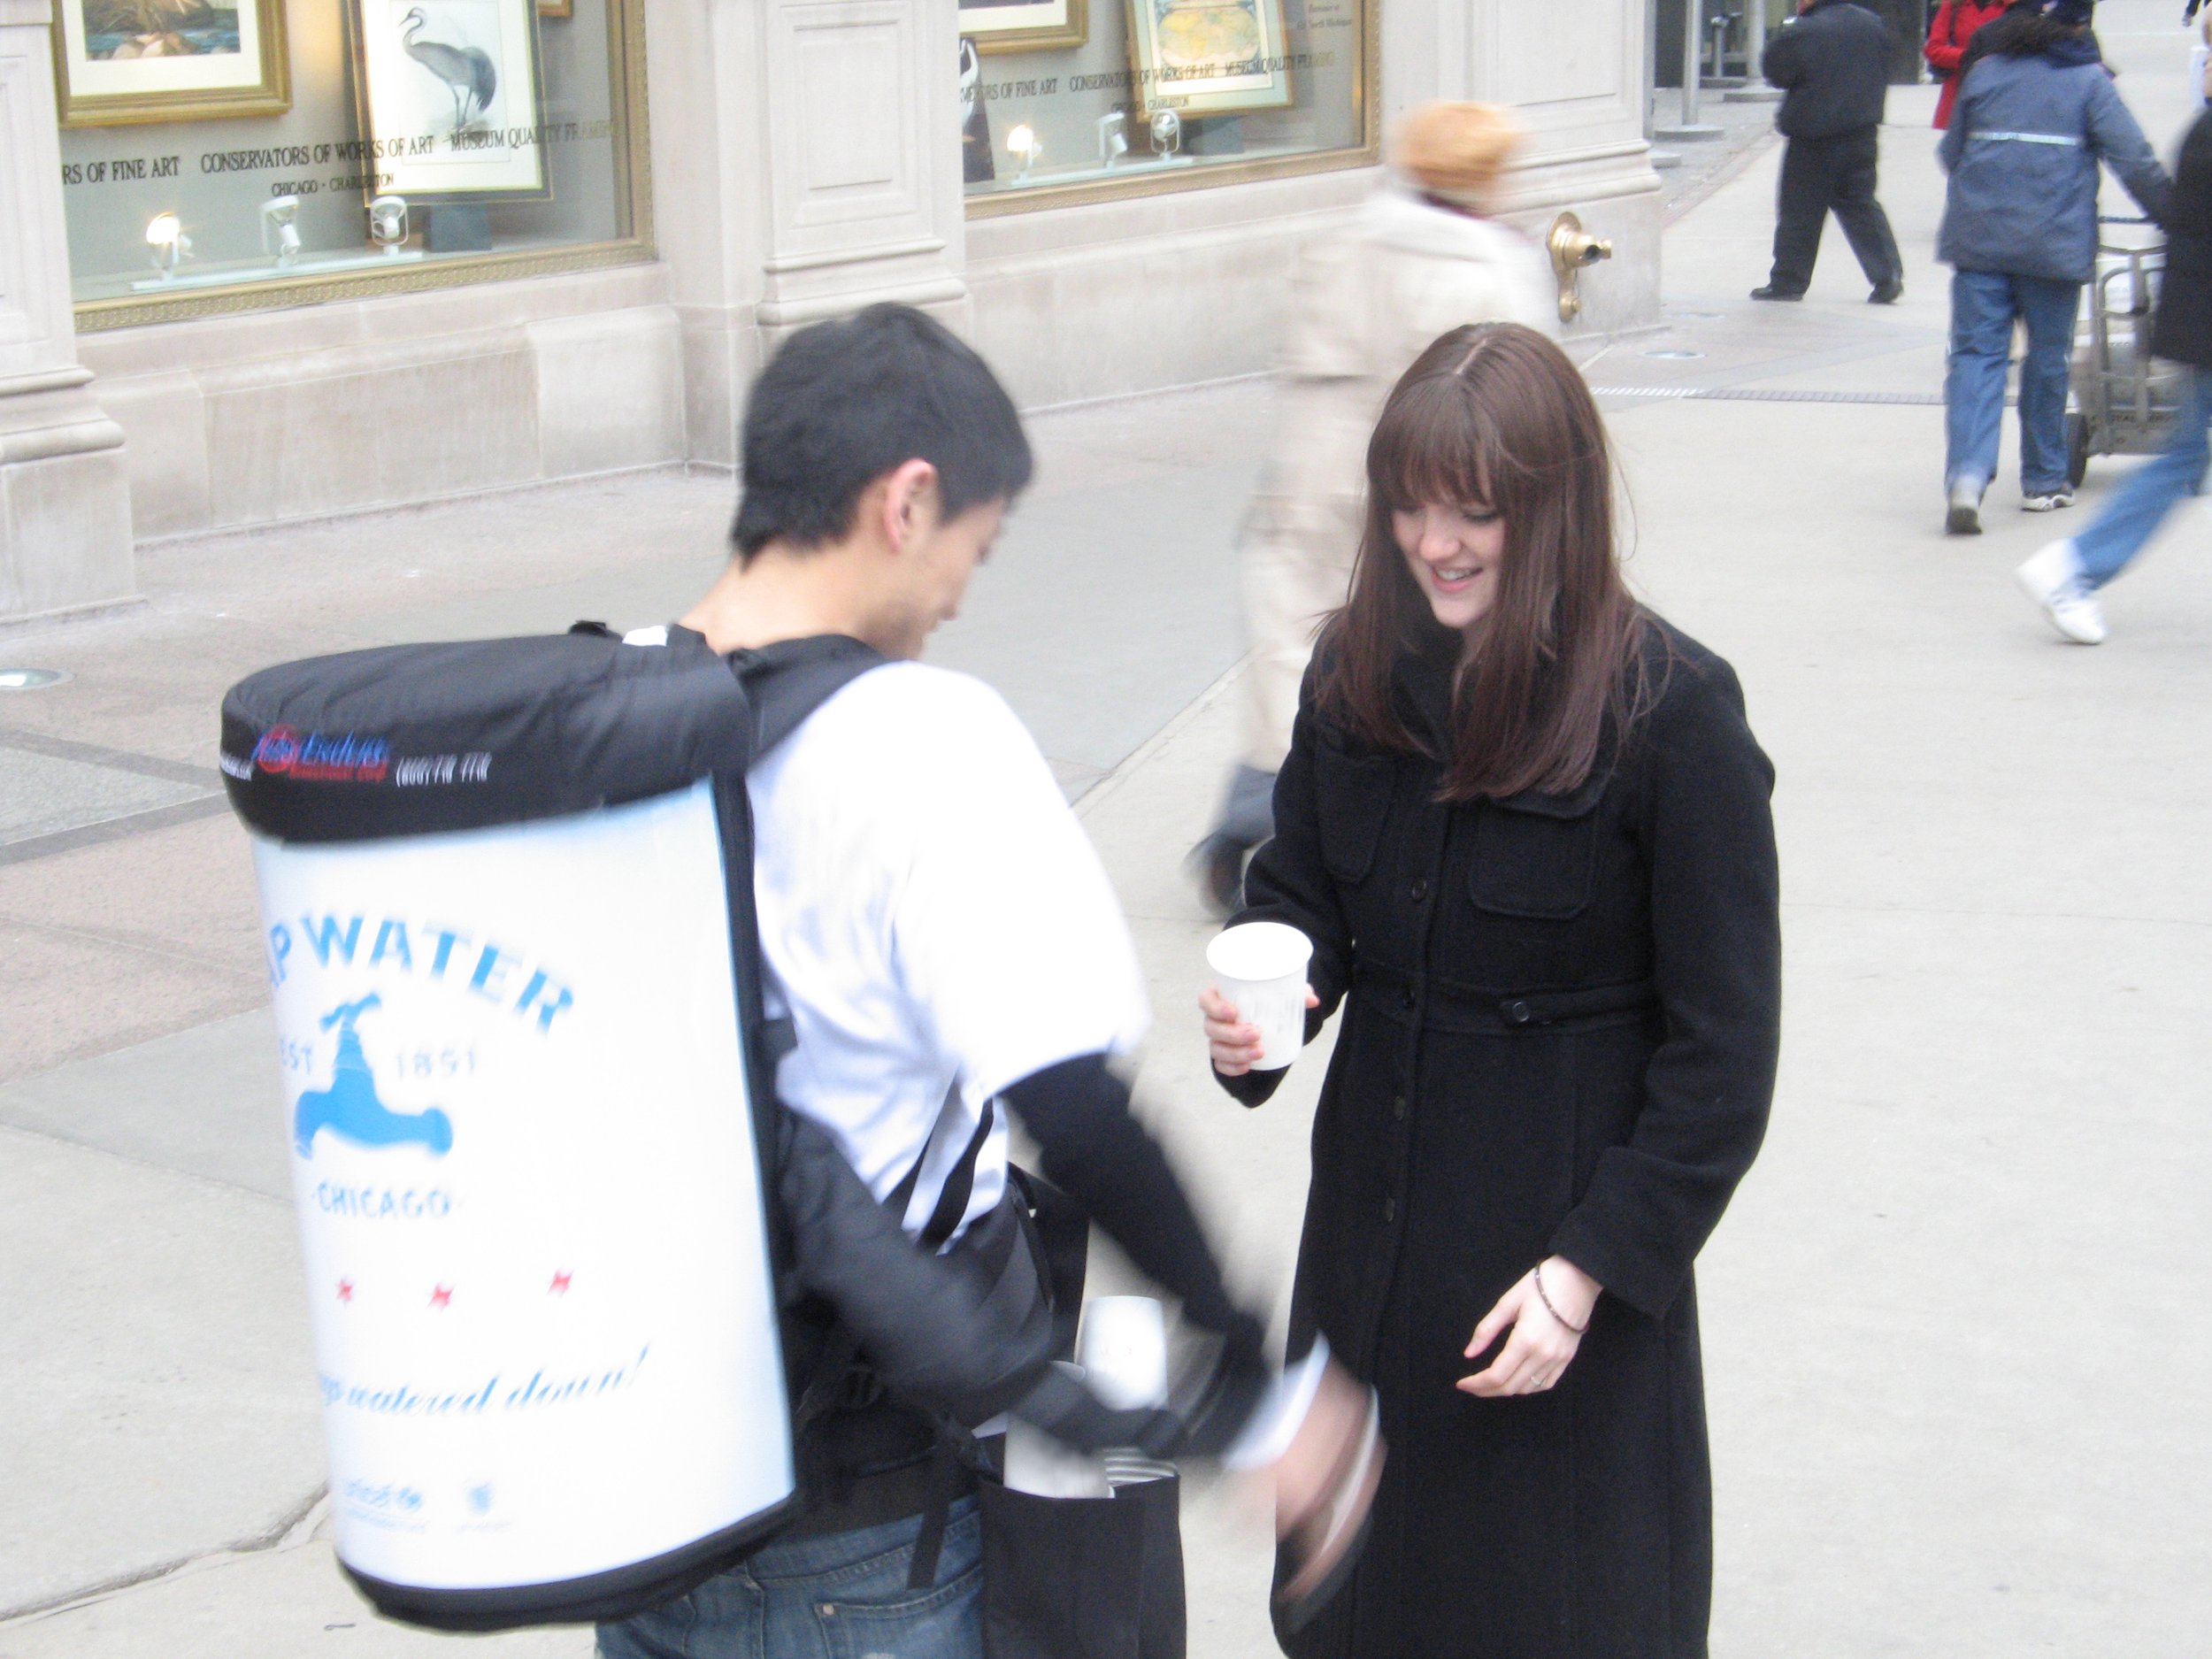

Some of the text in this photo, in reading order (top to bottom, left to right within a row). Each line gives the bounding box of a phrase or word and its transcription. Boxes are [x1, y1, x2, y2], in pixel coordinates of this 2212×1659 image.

[1040, 78, 1057, 95] ART
[87, 161, 106, 183] OF
[111, 158, 146, 181] FINE
[151, 155, 180, 178] ART
[201, 144, 310, 173] CONSERVATORS
[313, 142, 332, 164] OF
[334, 139, 385, 162] WORKS
[388, 137, 405, 157] OF
[409, 134, 434, 157] ART
[450, 128, 504, 152] MUSEUM
[508, 121, 561, 150] QUAITY
[271, 180, 319, 197] CHICAGO
[299, 915, 574, 1035] WATER
[317, 1179, 453, 1220] CHICAGO
